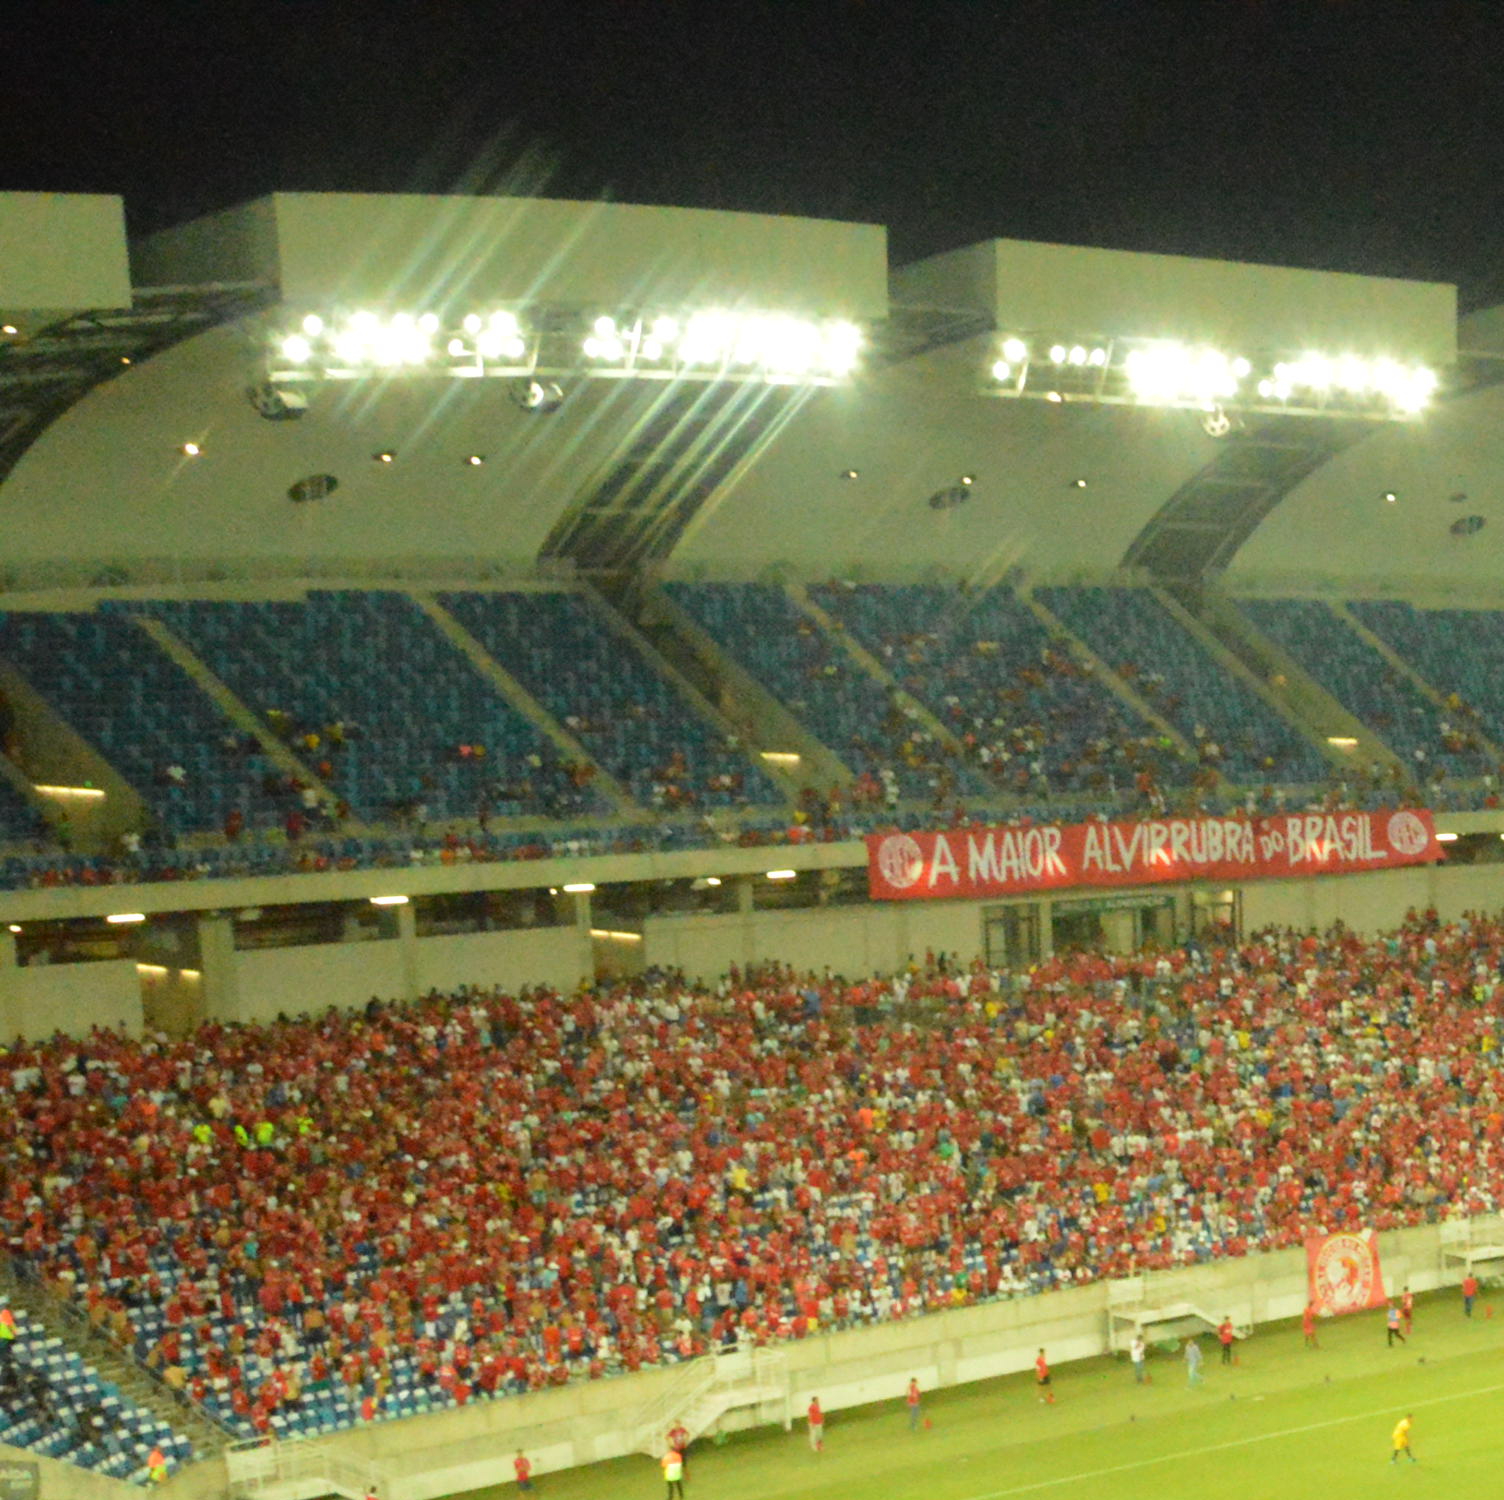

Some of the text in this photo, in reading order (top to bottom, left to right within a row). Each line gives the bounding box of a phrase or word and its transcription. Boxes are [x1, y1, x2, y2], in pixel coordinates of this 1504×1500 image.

[929, 834, 960, 889] A
[967, 827, 1066, 885] MAIOR
[1082, 819, 1257, 873] ALVIRRUBRA
[1287, 814, 1388, 868] BRASIL
